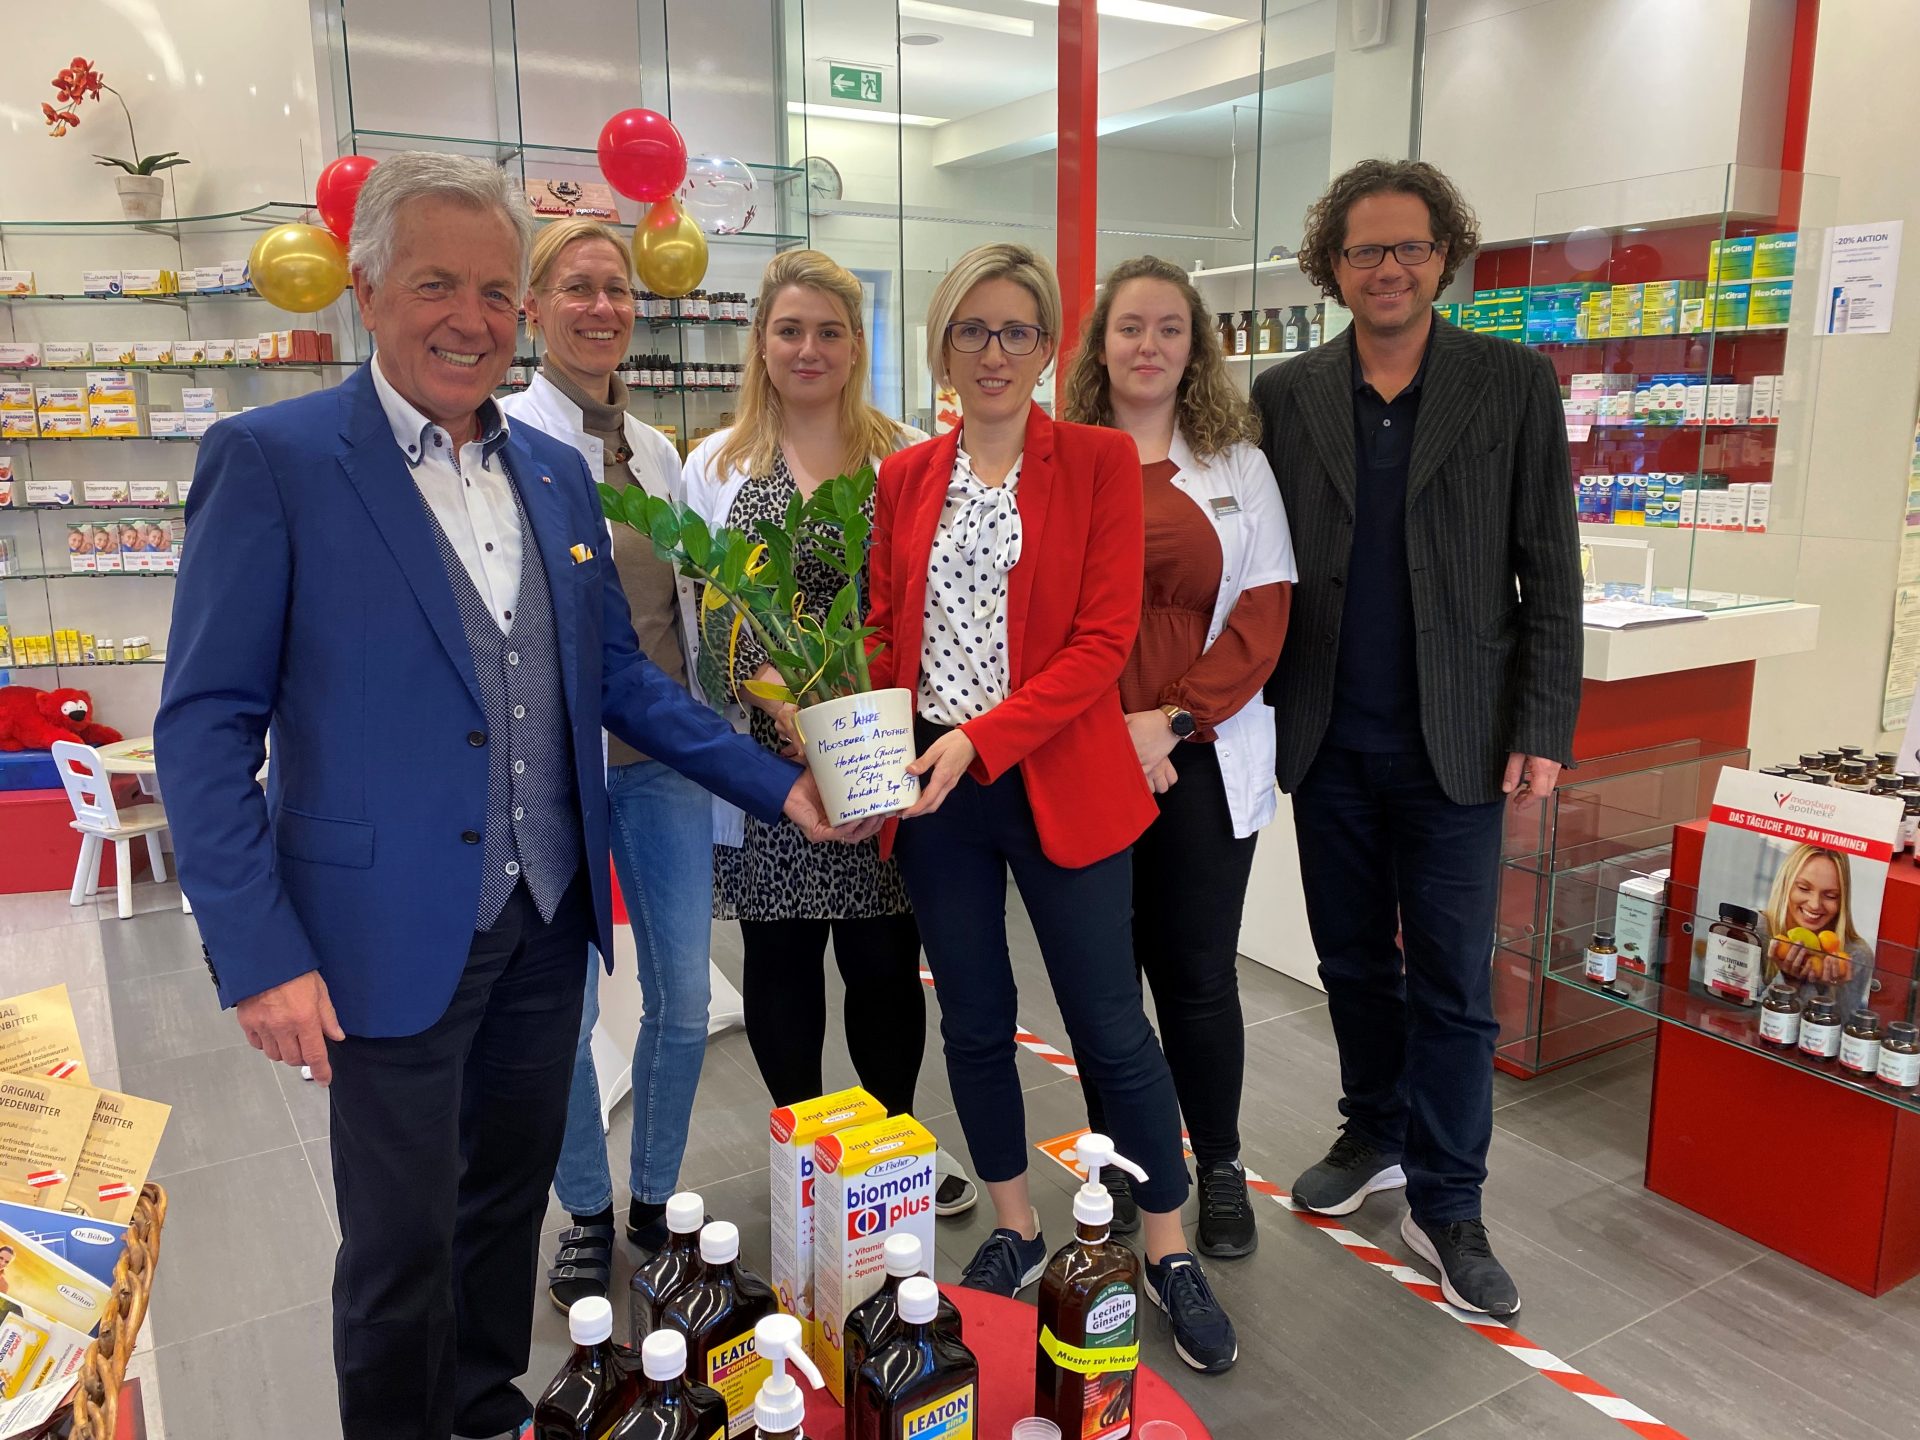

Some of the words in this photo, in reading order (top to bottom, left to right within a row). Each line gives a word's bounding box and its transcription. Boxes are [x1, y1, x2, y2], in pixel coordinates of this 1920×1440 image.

[1856, 234, 1888, 243] AKTION
[832, 716, 847, 732] 15
[1788, 804, 1834, 819] apotheke
[1790, 796, 1836, 813] moosburg
[1728, 812, 1744, 824] DAS
[1745, 813, 1784, 833] TÄGLICHE
[1784, 824, 1806, 838] PLUS
[1807, 830, 1820, 841] AN
[1821, 832, 1868, 852] VITAMINEN
[0, 1084, 45, 1100] ORIGINAL
[826, 1100, 867, 1116] biomont
[802, 1112, 824, 1122] plus
[848, 1140, 870, 1151] plus
[874, 1130, 916, 1145] biomont
[874, 1165, 884, 1174] Dr.
[885, 1158, 910, 1170] Fischer
[847, 1166, 932, 1210] biomont
[890, 1195, 930, 1228] plus
[75, 1230, 86, 1238] Dr.
[60, 1286, 70, 1296] Dr.
[1093, 1300, 1130, 1320] Lecithin
[1092, 1309, 1130, 1330] Ginseng
[1056, 1350, 1090, 1366] Muster
[1094, 1357, 1106, 1365] zur
[908, 1394, 968, 1436] LEATON
